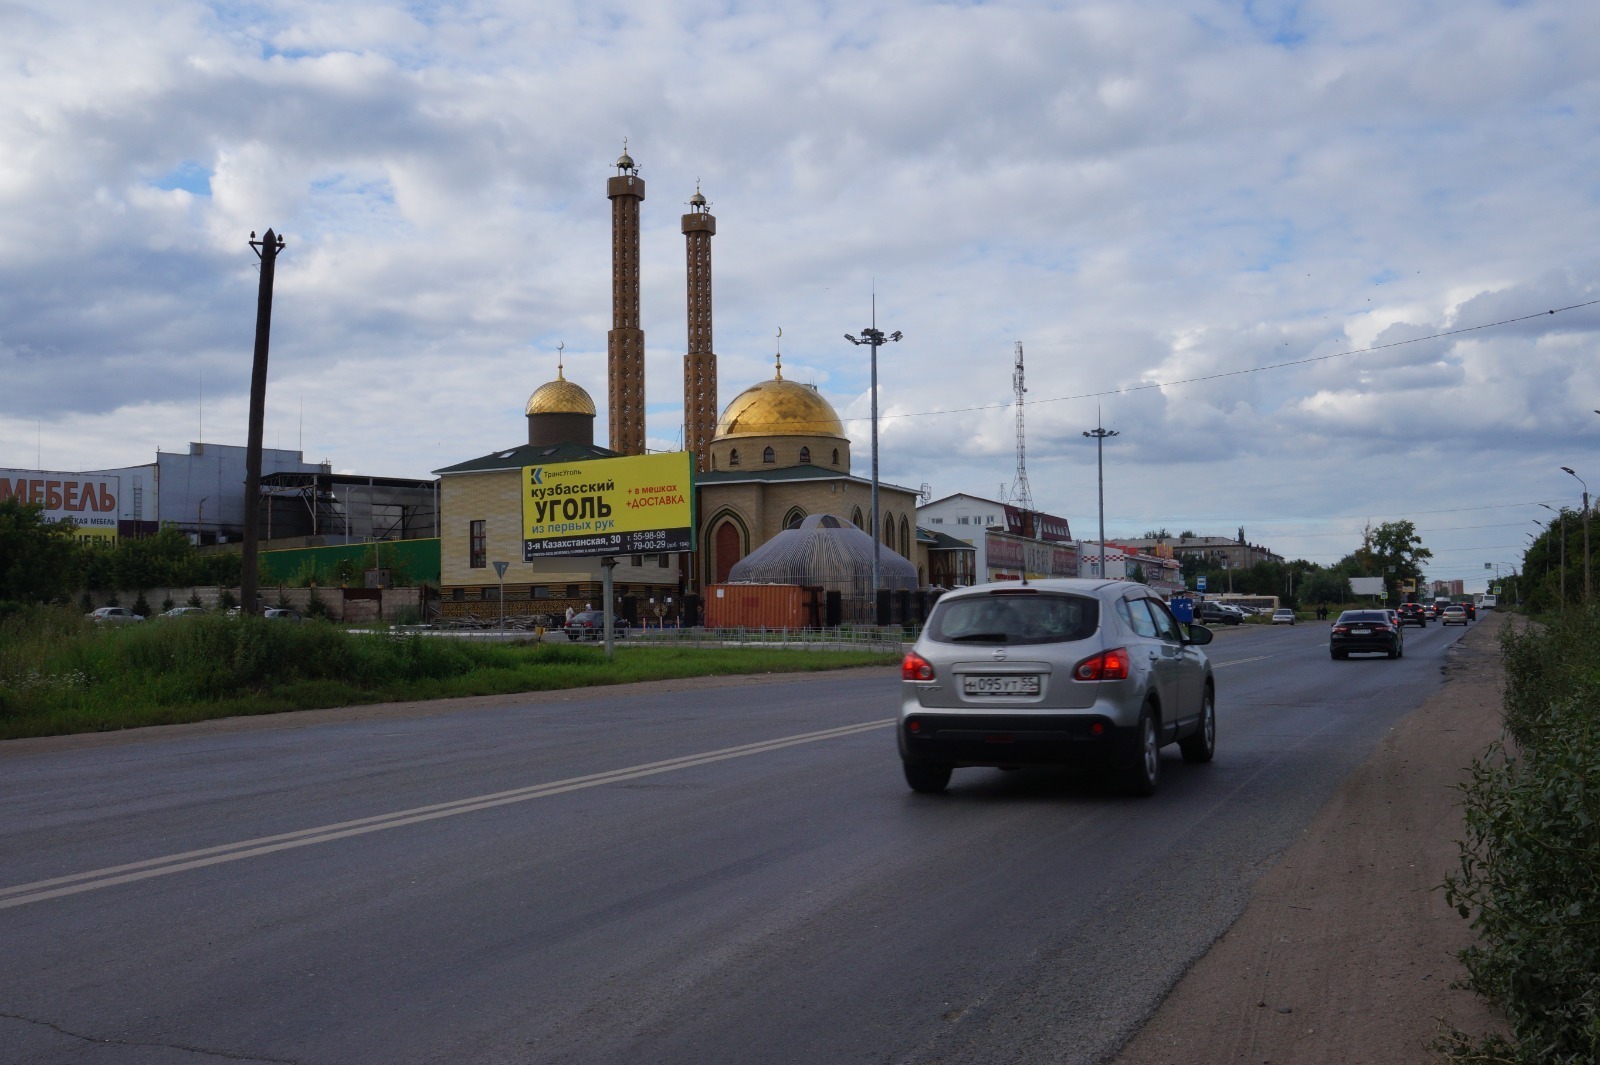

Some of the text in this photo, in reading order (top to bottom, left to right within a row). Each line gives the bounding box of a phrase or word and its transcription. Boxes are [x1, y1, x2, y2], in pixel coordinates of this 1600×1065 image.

[543, 469, 582, 479] ТрансУголь
[0, 477, 116, 512] МЕБЕЛЬ
[531, 479, 615, 499] кузбасский
[641, 484, 678, 494] мешках
[535, 495, 612, 523] УГОЛЬ
[626, 494, 685, 509] +ДОСТАВКА
[90, 518, 115, 526] МЕБЕЛЬ
[532, 518, 615, 534] из первых рук
[527, 534, 621, 550] 3-я Казахстанская, 30
[633, 530, 666, 541] 55-98-98
[633, 540, 666, 550] 79-00-29
